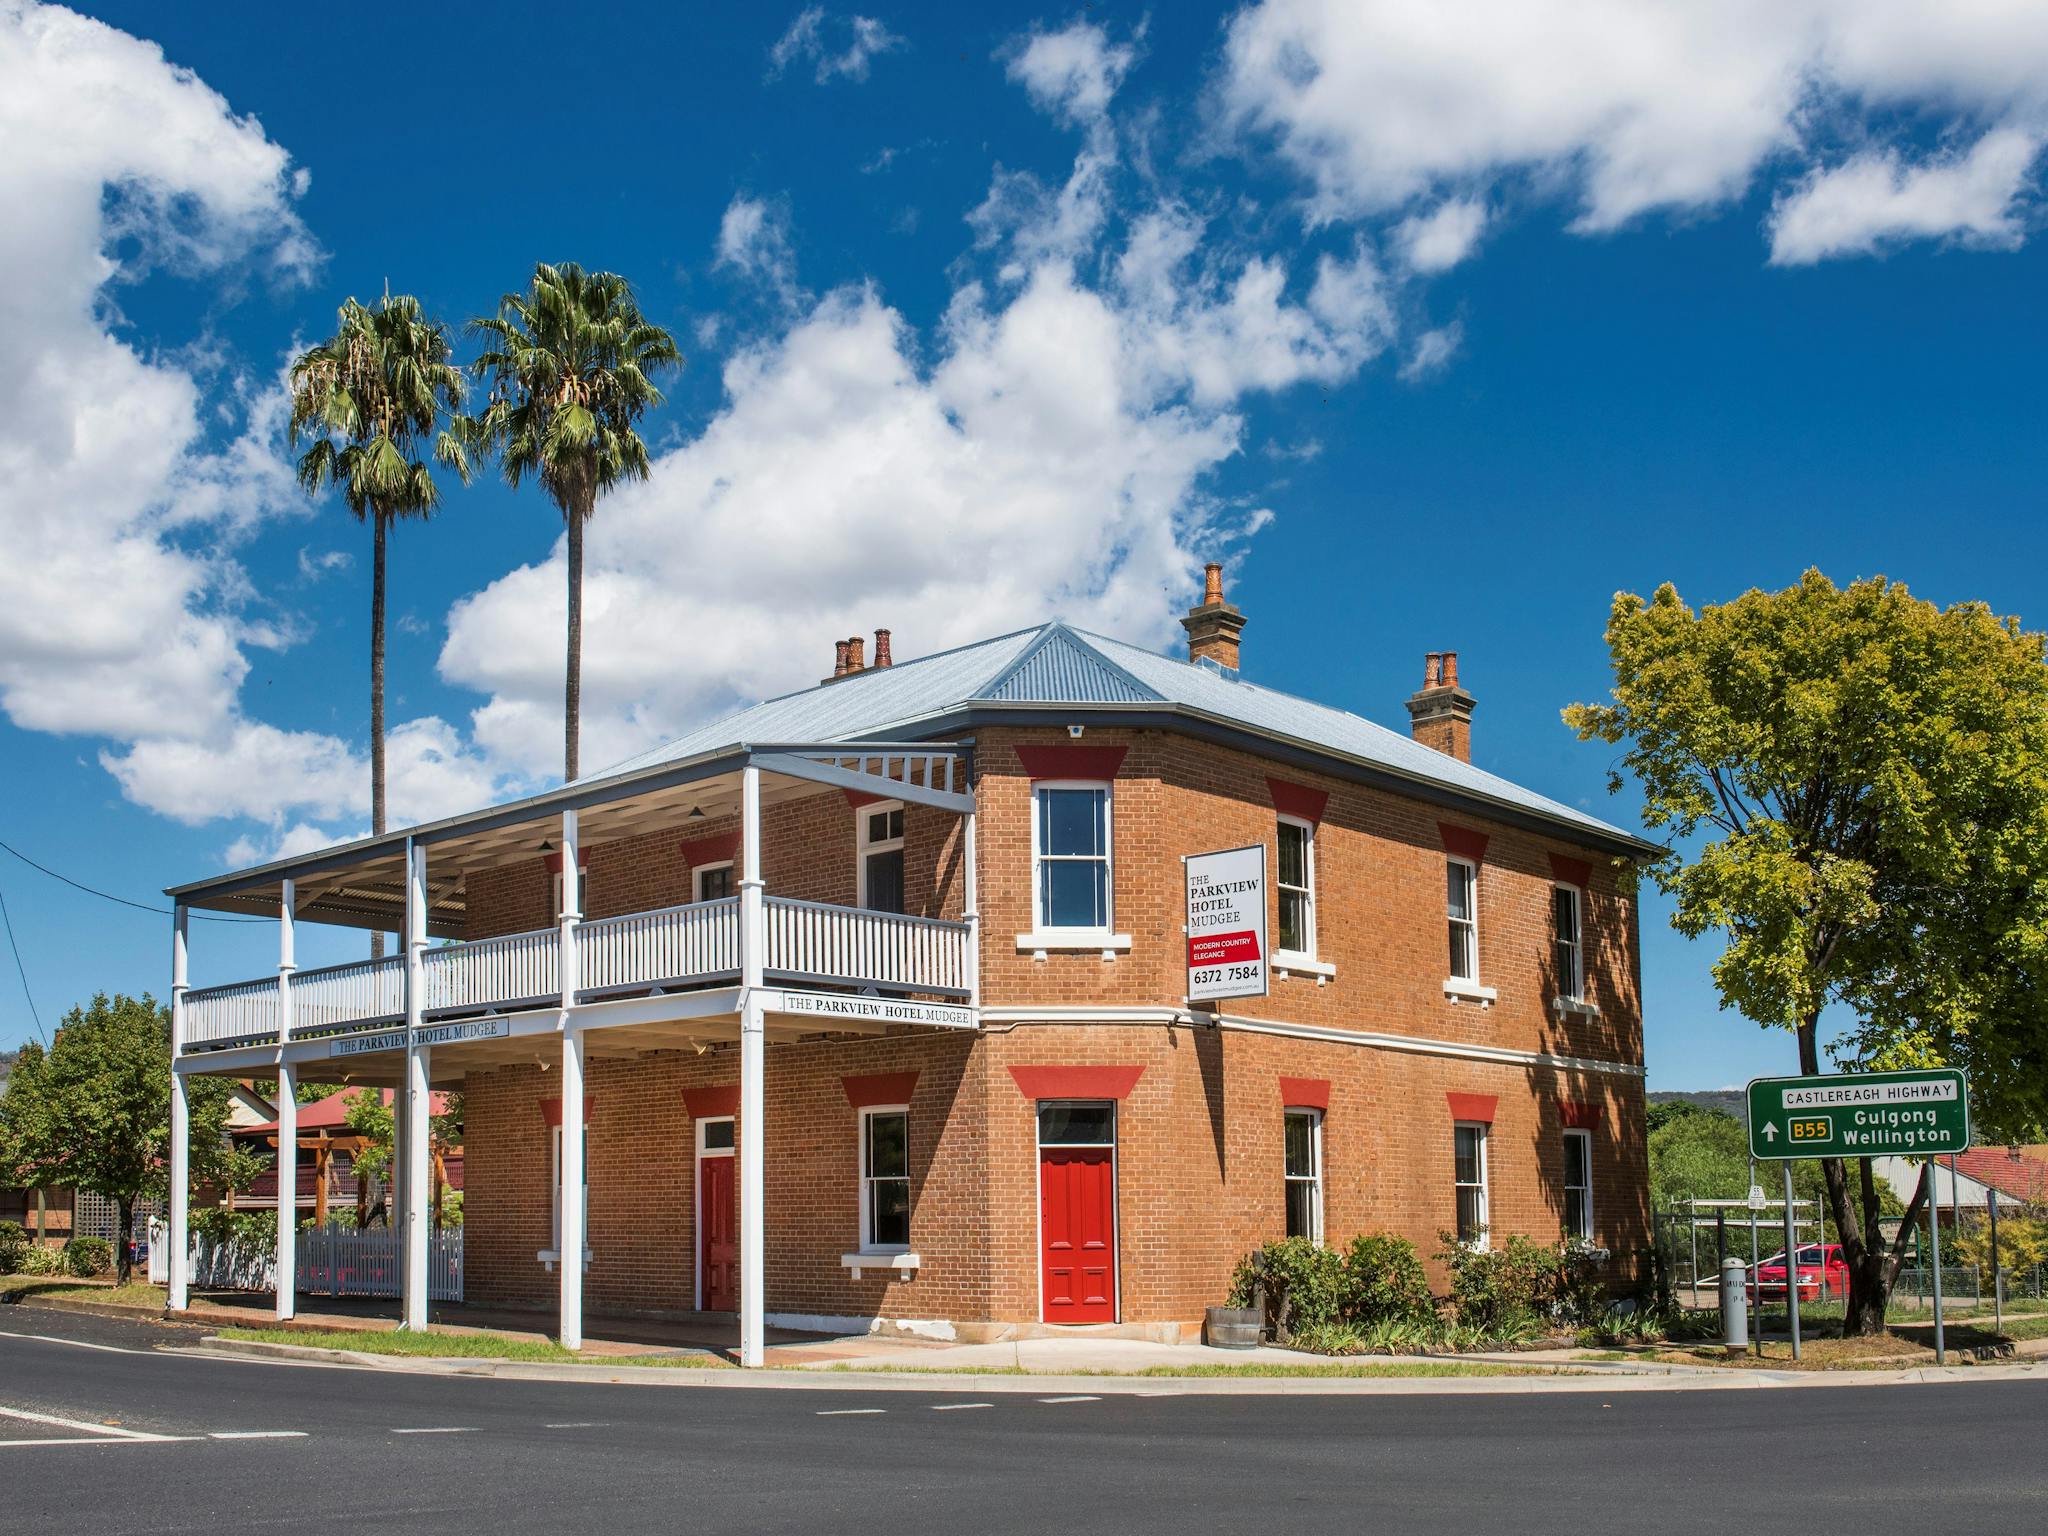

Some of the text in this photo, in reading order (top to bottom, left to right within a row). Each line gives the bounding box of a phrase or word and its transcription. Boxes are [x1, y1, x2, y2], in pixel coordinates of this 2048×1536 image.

[1190, 875, 1210, 886] THE
[1191, 879, 1259, 899] PARKVIEW
[1191, 898, 1233, 914] HOTEL
[1191, 911, 1241, 928] MUDGEE
[1193, 937, 1251, 951] MODERN COUNTRY
[1193, 950, 1226, 960] ELEGANCE
[1194, 965, 1259, 984] 6372 7584
[788, 996, 969, 1024] THE PARKVIEW HOTEL MUDGEE
[338, 1040, 356, 1053] THE
[417, 1027, 452, 1044] HOTEL
[454, 1021, 497, 1039] MUDGEE
[1786, 1084, 1952, 1104] CASTLEREAGH HIGHWAY
[1854, 1109, 1937, 1128] Gulgong
[1793, 1122, 1828, 1138] B55
[1843, 1129, 1951, 1148] Wellington
